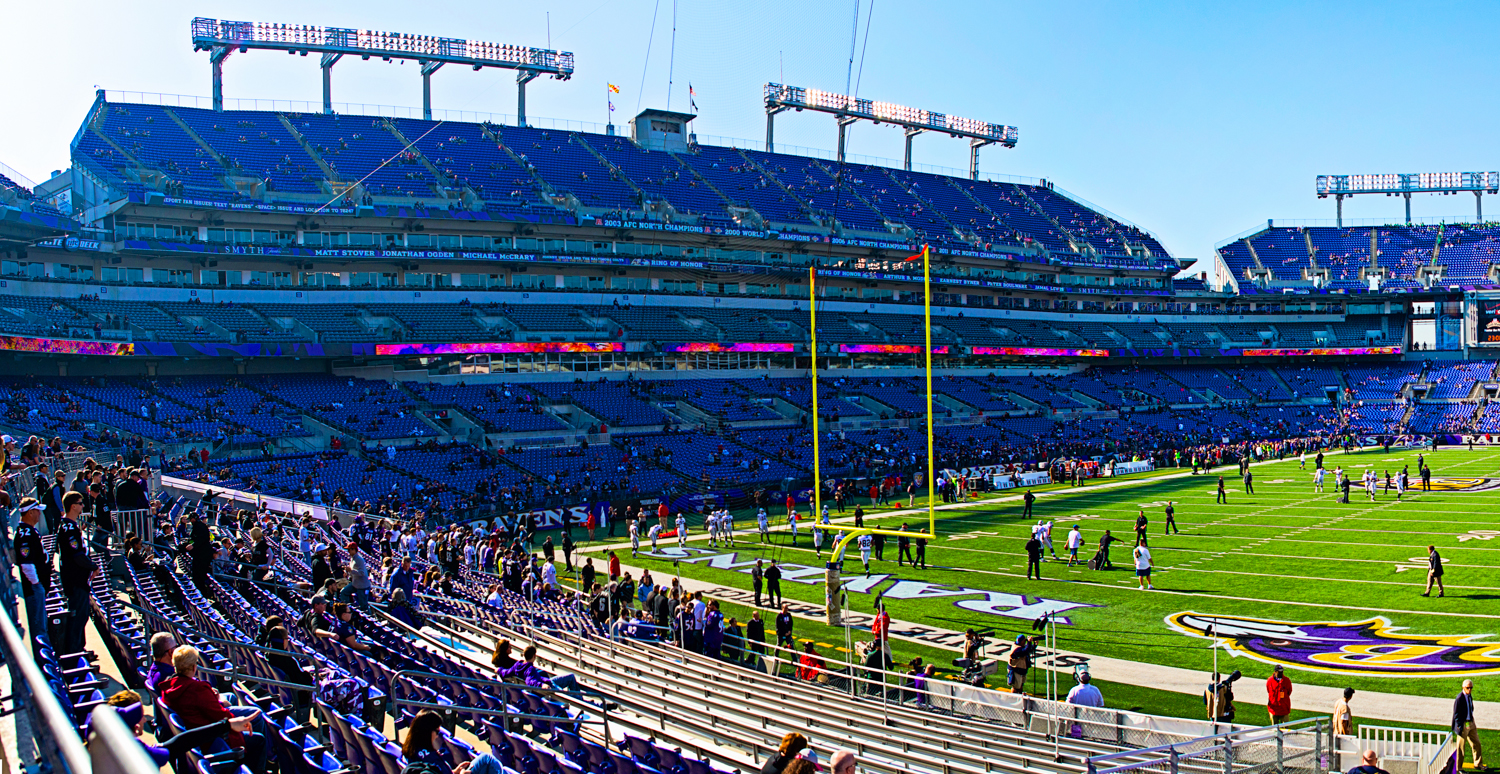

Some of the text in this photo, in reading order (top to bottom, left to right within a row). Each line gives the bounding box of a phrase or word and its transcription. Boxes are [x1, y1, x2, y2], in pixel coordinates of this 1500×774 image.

[604, 220, 621, 228] 2003
[638, 222, 664, 230] NORTH
[664, 224, 703, 233] CHAMPIONS
[742, 230, 764, 238] WORLD
[79, 240, 100, 249] DECK
[859, 240, 878, 248] NORTH
[879, 242, 910, 250] CHAMPIONS
[225, 246, 264, 254] SMYTH
[499, 253, 535, 261] McCRARY
[979, 252, 1007, 260] CHAMPIONS
[62, 523, 74, 532] 52
[19, 527, 31, 538] 52
[862, 539, 871, 548] 82
[638, 546, 1106, 625] RAVENS
[418, 748, 430, 759] 92
